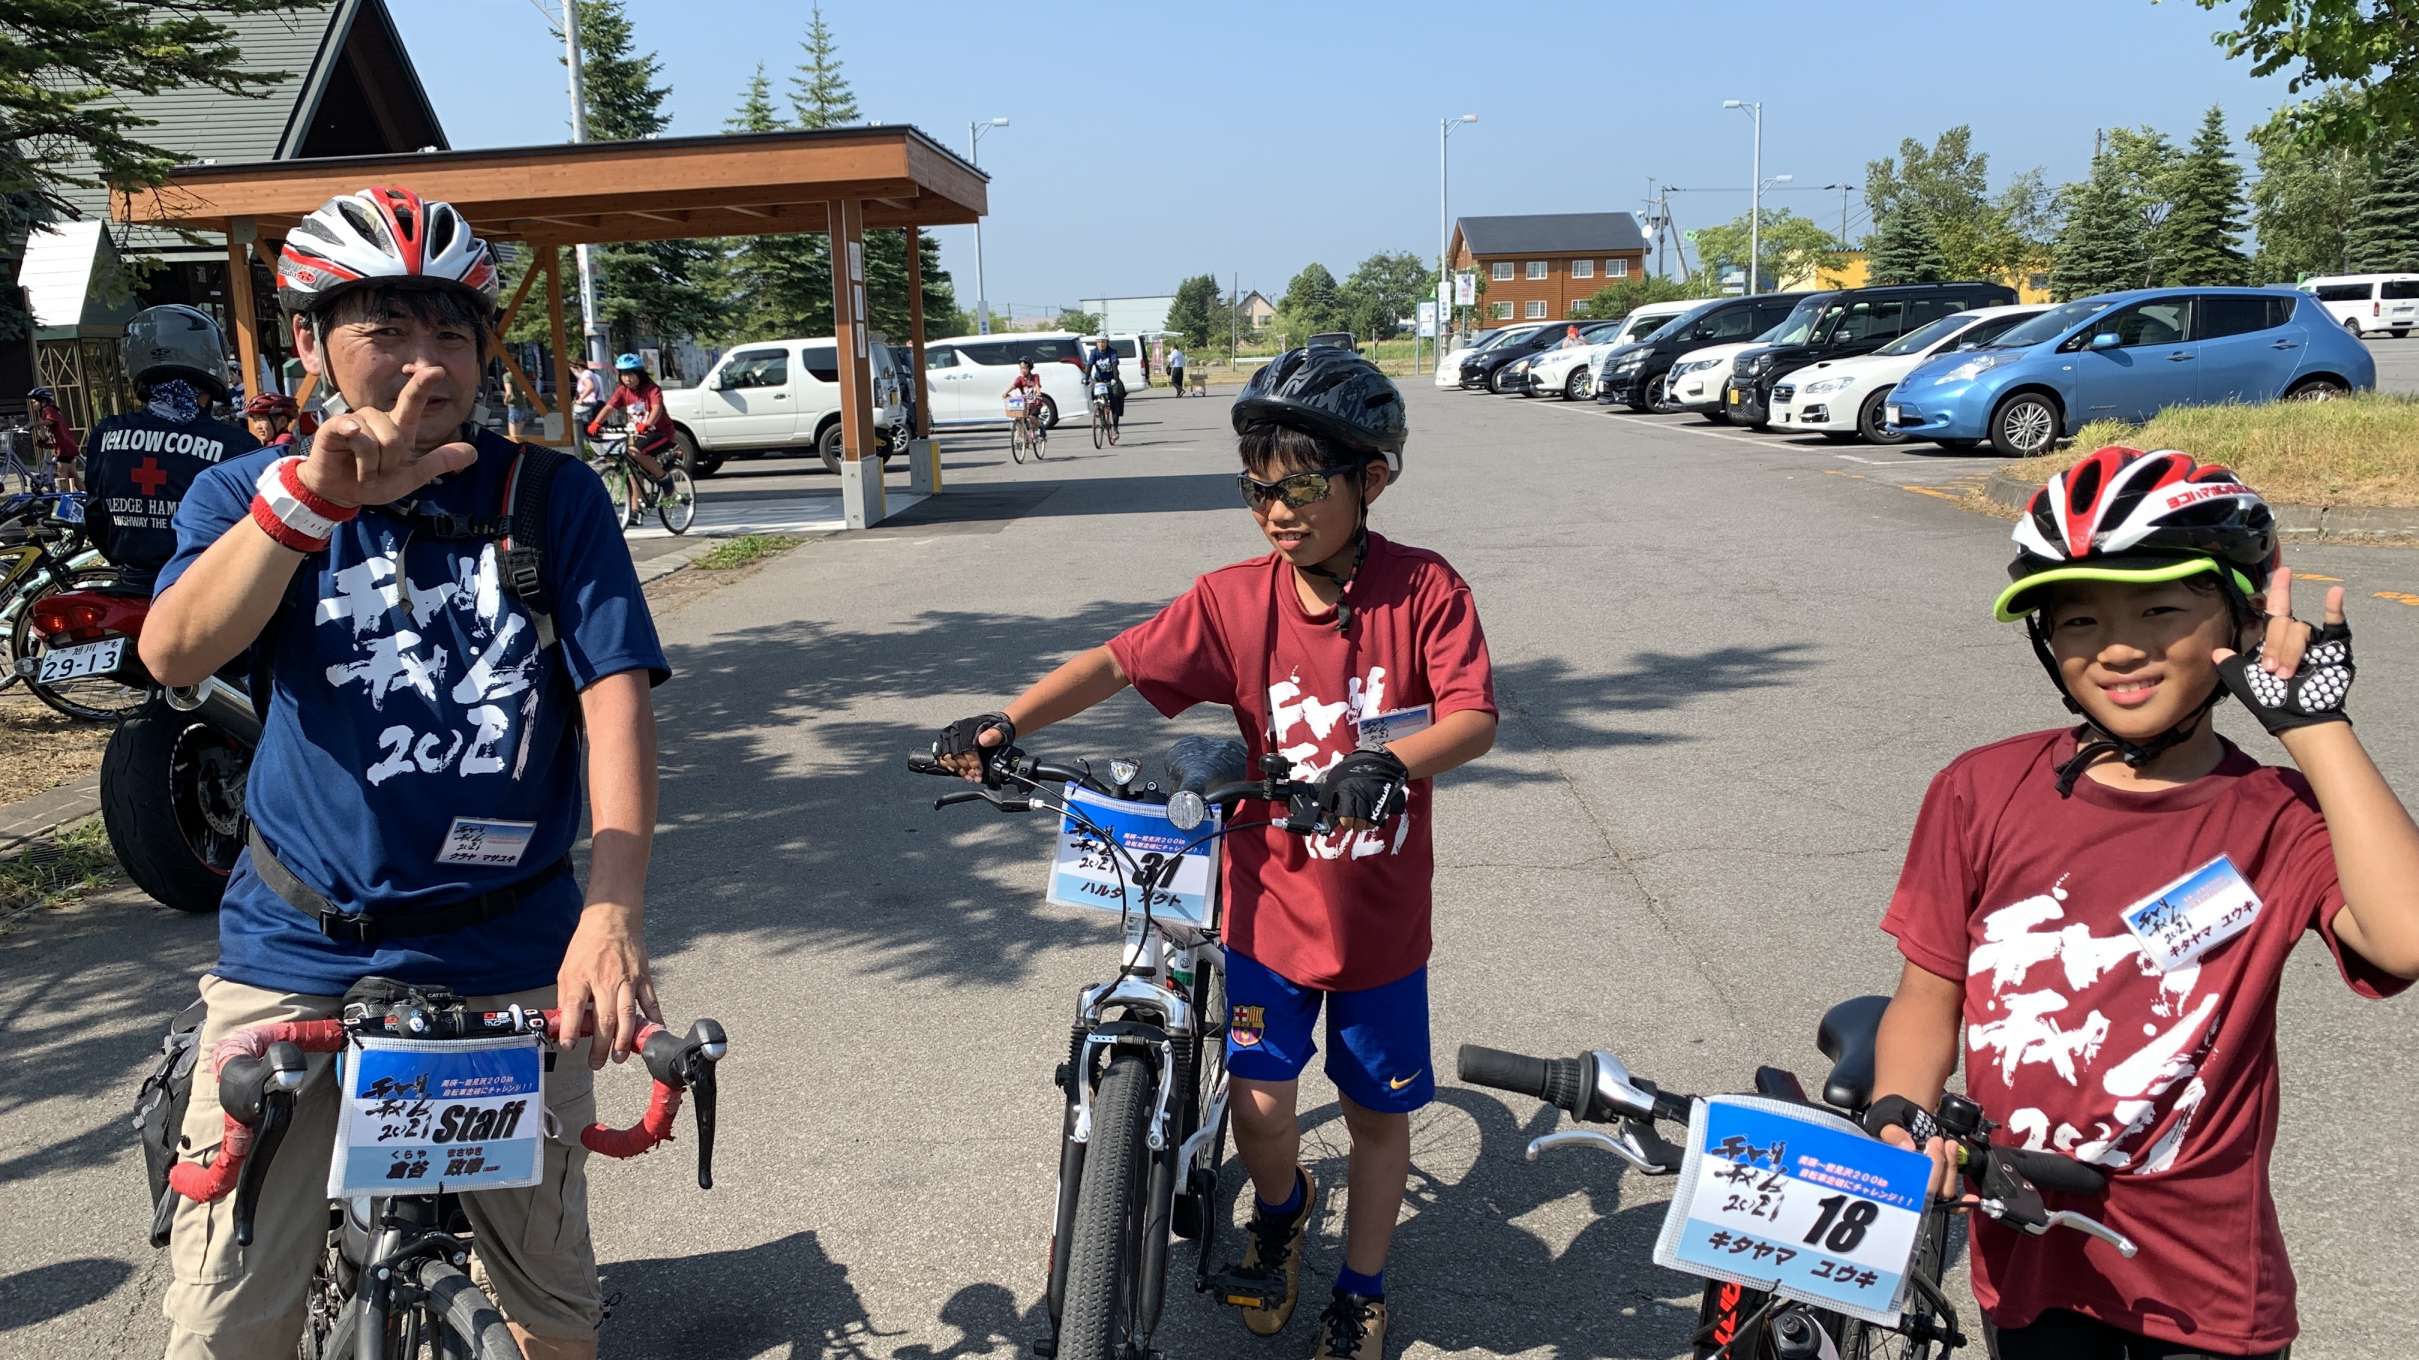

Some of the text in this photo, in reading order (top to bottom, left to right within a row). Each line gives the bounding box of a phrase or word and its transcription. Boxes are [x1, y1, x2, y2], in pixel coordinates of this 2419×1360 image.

[106, 498, 177, 516] LEDGE HAM
[113, 515, 167, 528] HIGHWAY THE
[42, 651, 117, 681] 29-13
[367, 704, 539, 787] 2021
[1132, 853, 1184, 889] 31
[2170, 900, 2255, 957] キタヤマ ユウキ
[378, 1113, 432, 1142] 2021
[432, 1100, 527, 1144] Staff
[1723, 1194, 1783, 1223] 2021
[1803, 1195, 1880, 1253] 18
[1708, 1231, 1879, 1289] キタヤマ ユウキ
